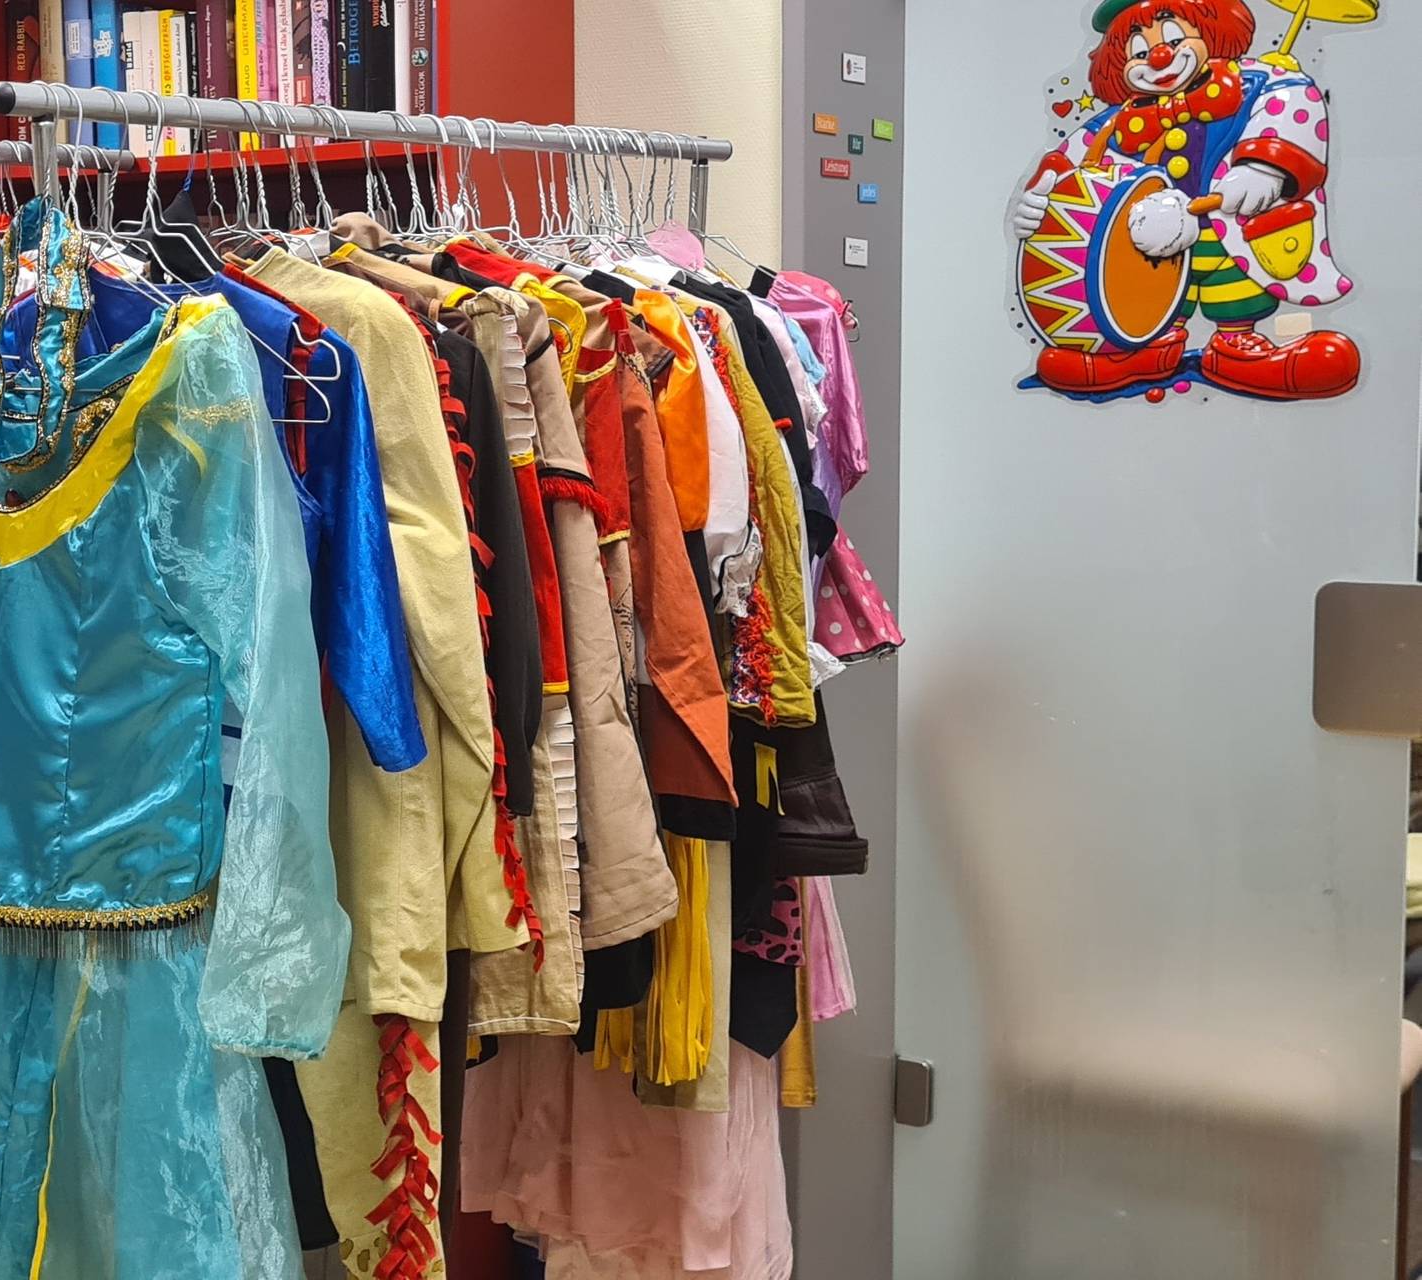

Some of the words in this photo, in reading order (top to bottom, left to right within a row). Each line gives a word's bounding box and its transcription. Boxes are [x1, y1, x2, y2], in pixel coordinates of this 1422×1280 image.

[15, 19, 26, 51] RABBIT
[347, 0, 361, 65] BETROGE
[418, 0, 426, 41] HIGHLAN
[16, 52, 26, 71] RED
[280, 53, 289, 82] Hensel
[281, 83, 290, 104] eorg
[824, 159, 849, 177] Leistung
